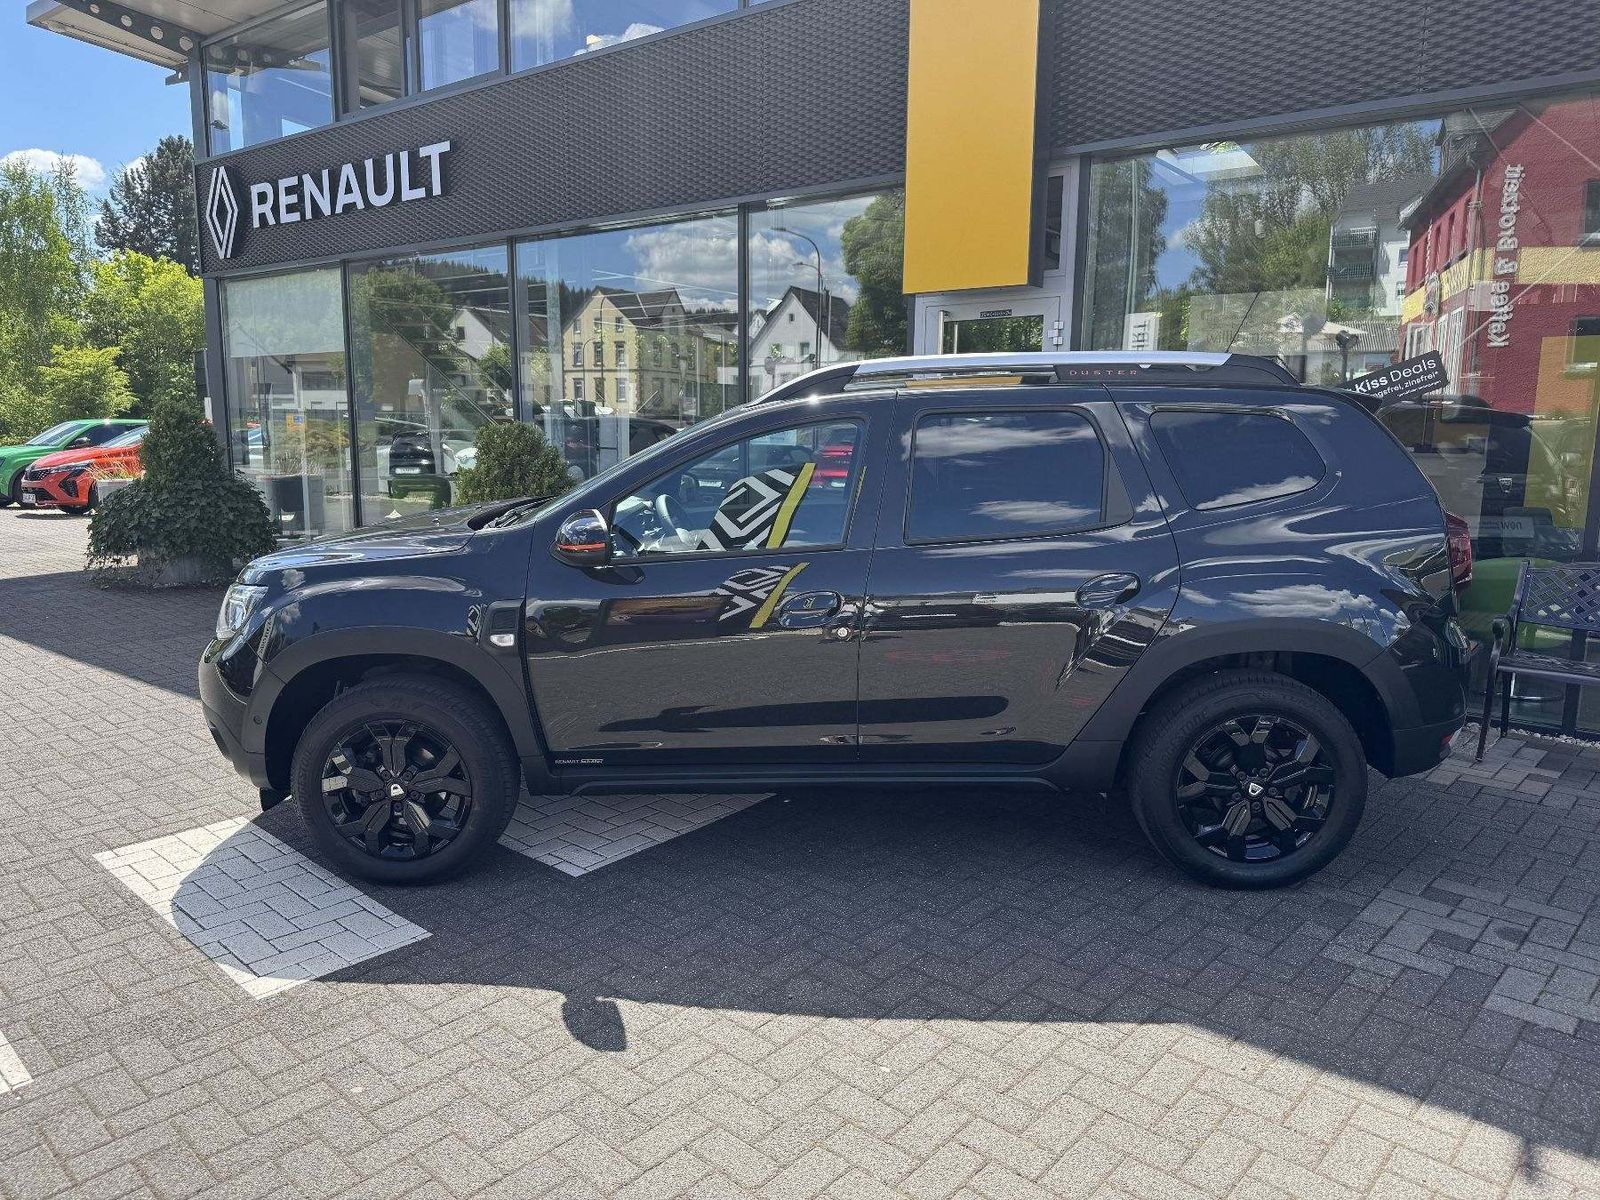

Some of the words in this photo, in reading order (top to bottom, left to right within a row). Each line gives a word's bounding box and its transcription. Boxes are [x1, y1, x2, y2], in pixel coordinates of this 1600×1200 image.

[250, 141, 450, 229] RENAULT
[1355, 376, 1388, 393] Kiss
[1390, 359, 1437, 382] Deals
[1370, 384, 1404, 399] ngsfrei,
